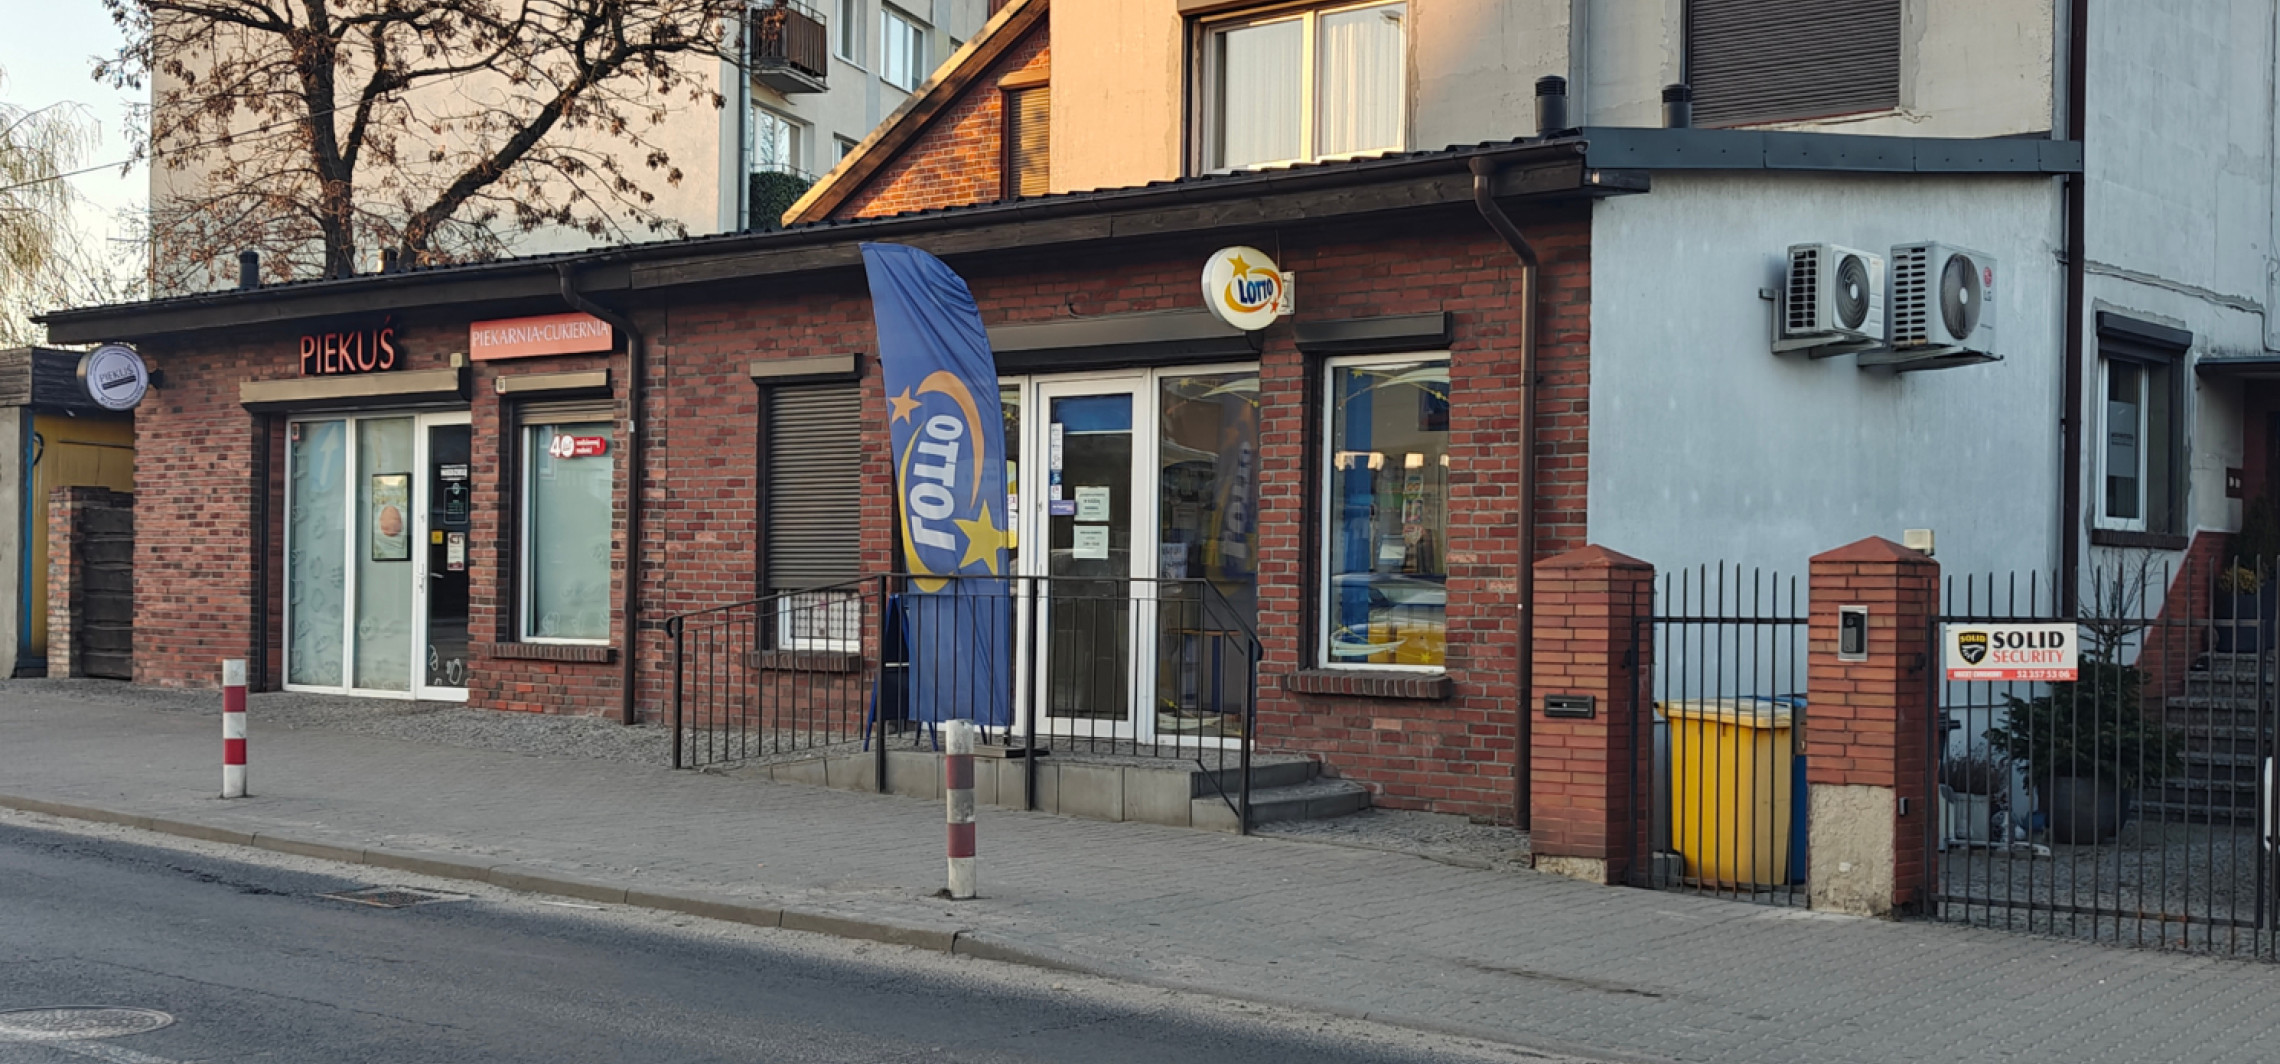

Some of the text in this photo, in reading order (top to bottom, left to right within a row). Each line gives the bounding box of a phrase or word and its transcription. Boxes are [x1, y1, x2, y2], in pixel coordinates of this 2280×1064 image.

[1238, 278, 1274, 305] LOTTO
[299, 314, 395, 376] PIEKUŚ
[909, 414, 964, 551] LOTTO
[1960, 633, 1986, 643] SOLID
[1992, 631, 2065, 649] SOLID
[1992, 649, 2065, 663] SECURITY
